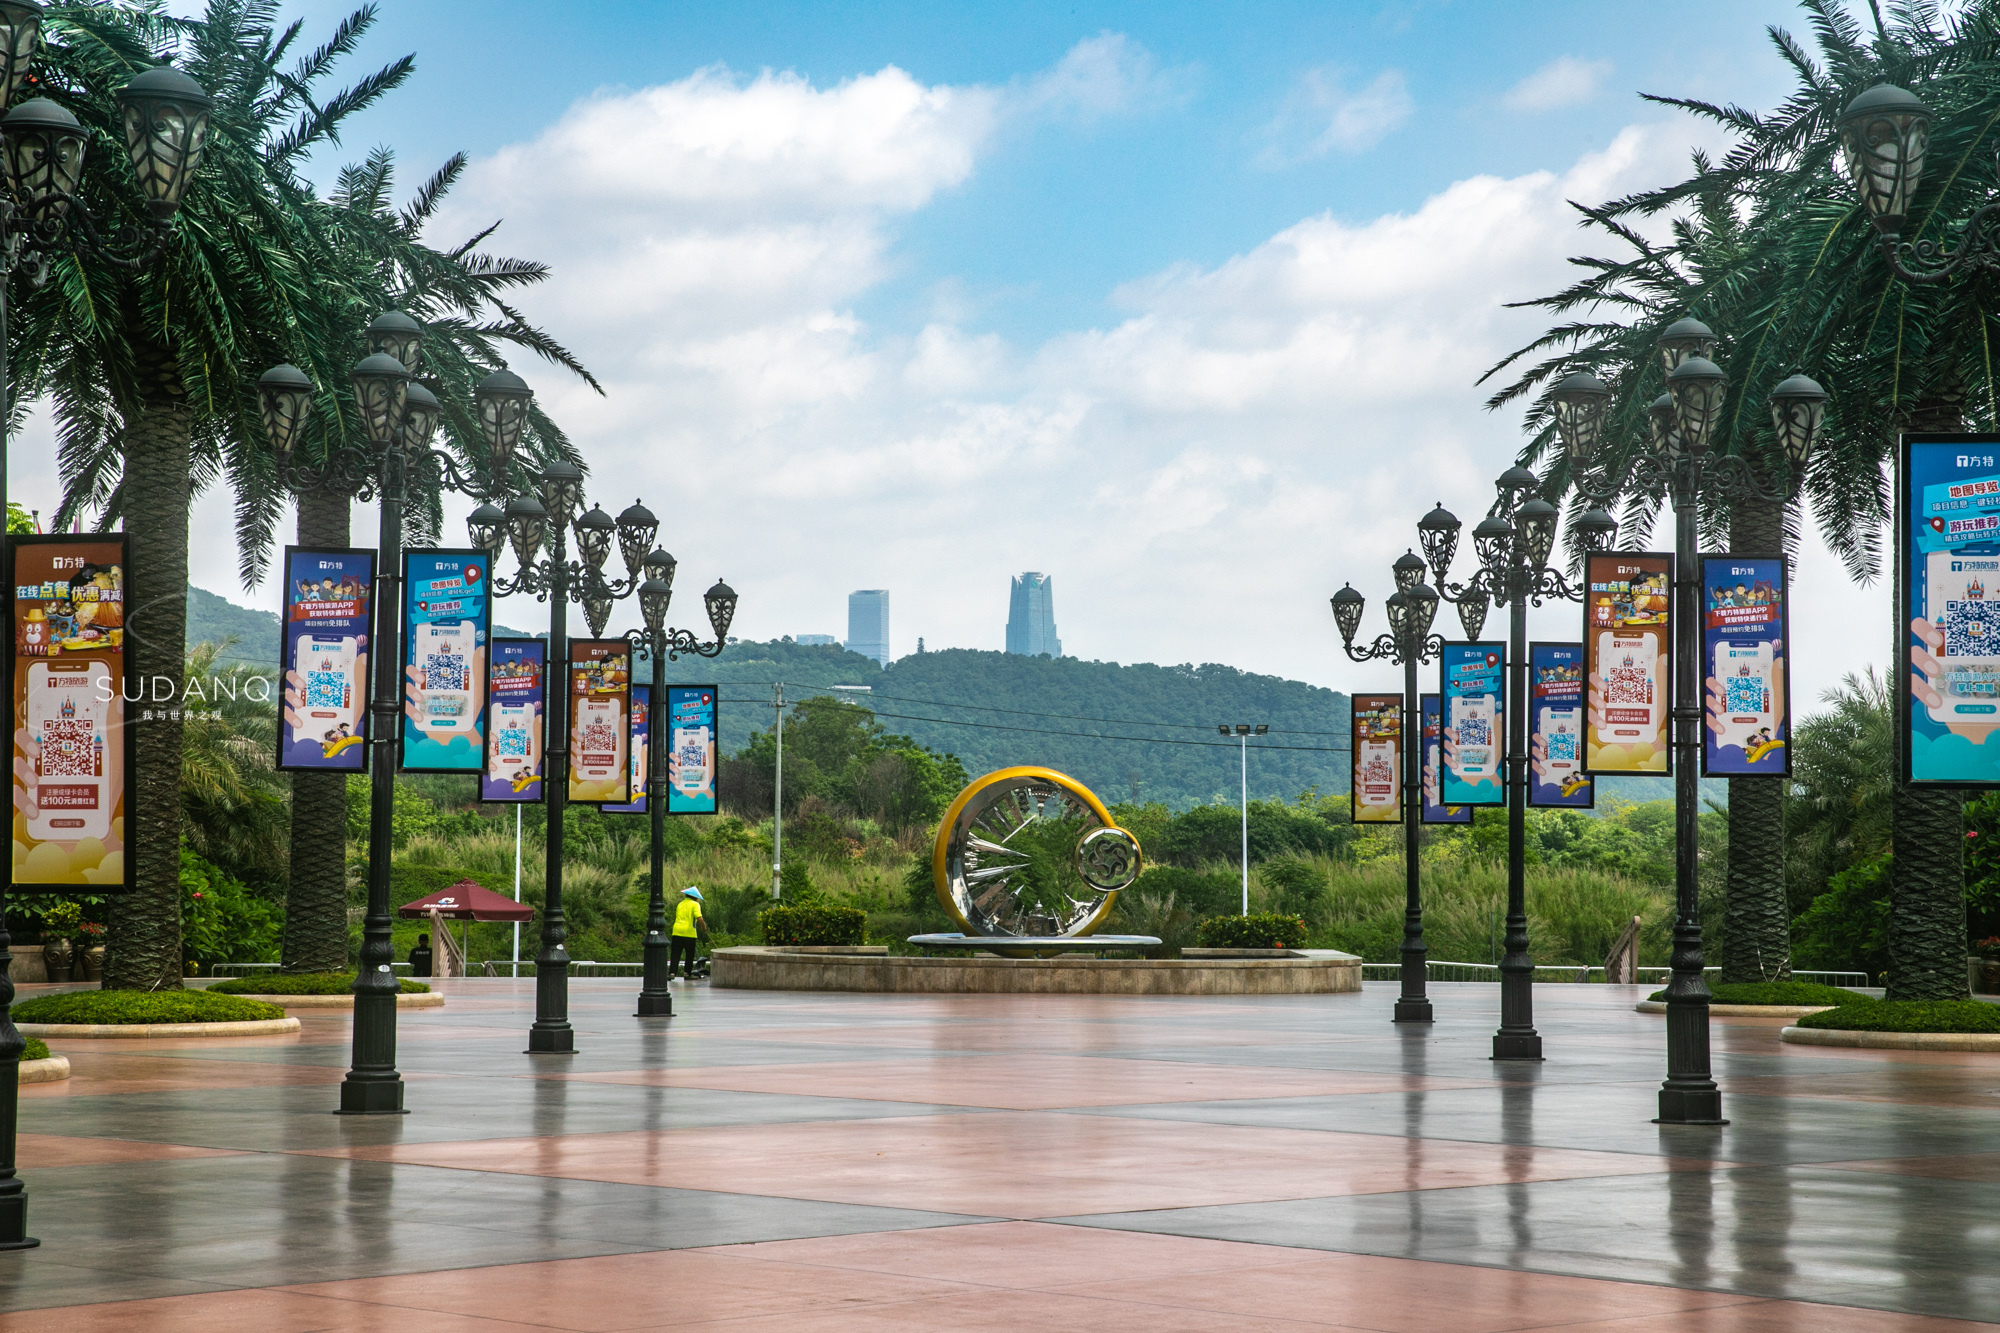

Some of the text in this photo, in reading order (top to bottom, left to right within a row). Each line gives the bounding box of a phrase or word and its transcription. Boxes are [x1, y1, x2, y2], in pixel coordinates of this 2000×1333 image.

[1969, 455, 1995, 467] 方特
[1948, 480, 2000, 499] 地图导览
[1948, 515, 2000, 533] 游玩推荐
[1943, 529, 2000, 543] 精选攻略玩转方
[16, 581, 122, 603] 在线点餐 优惠满减
[1714, 606, 1768, 618] 下载方特旅游APP
